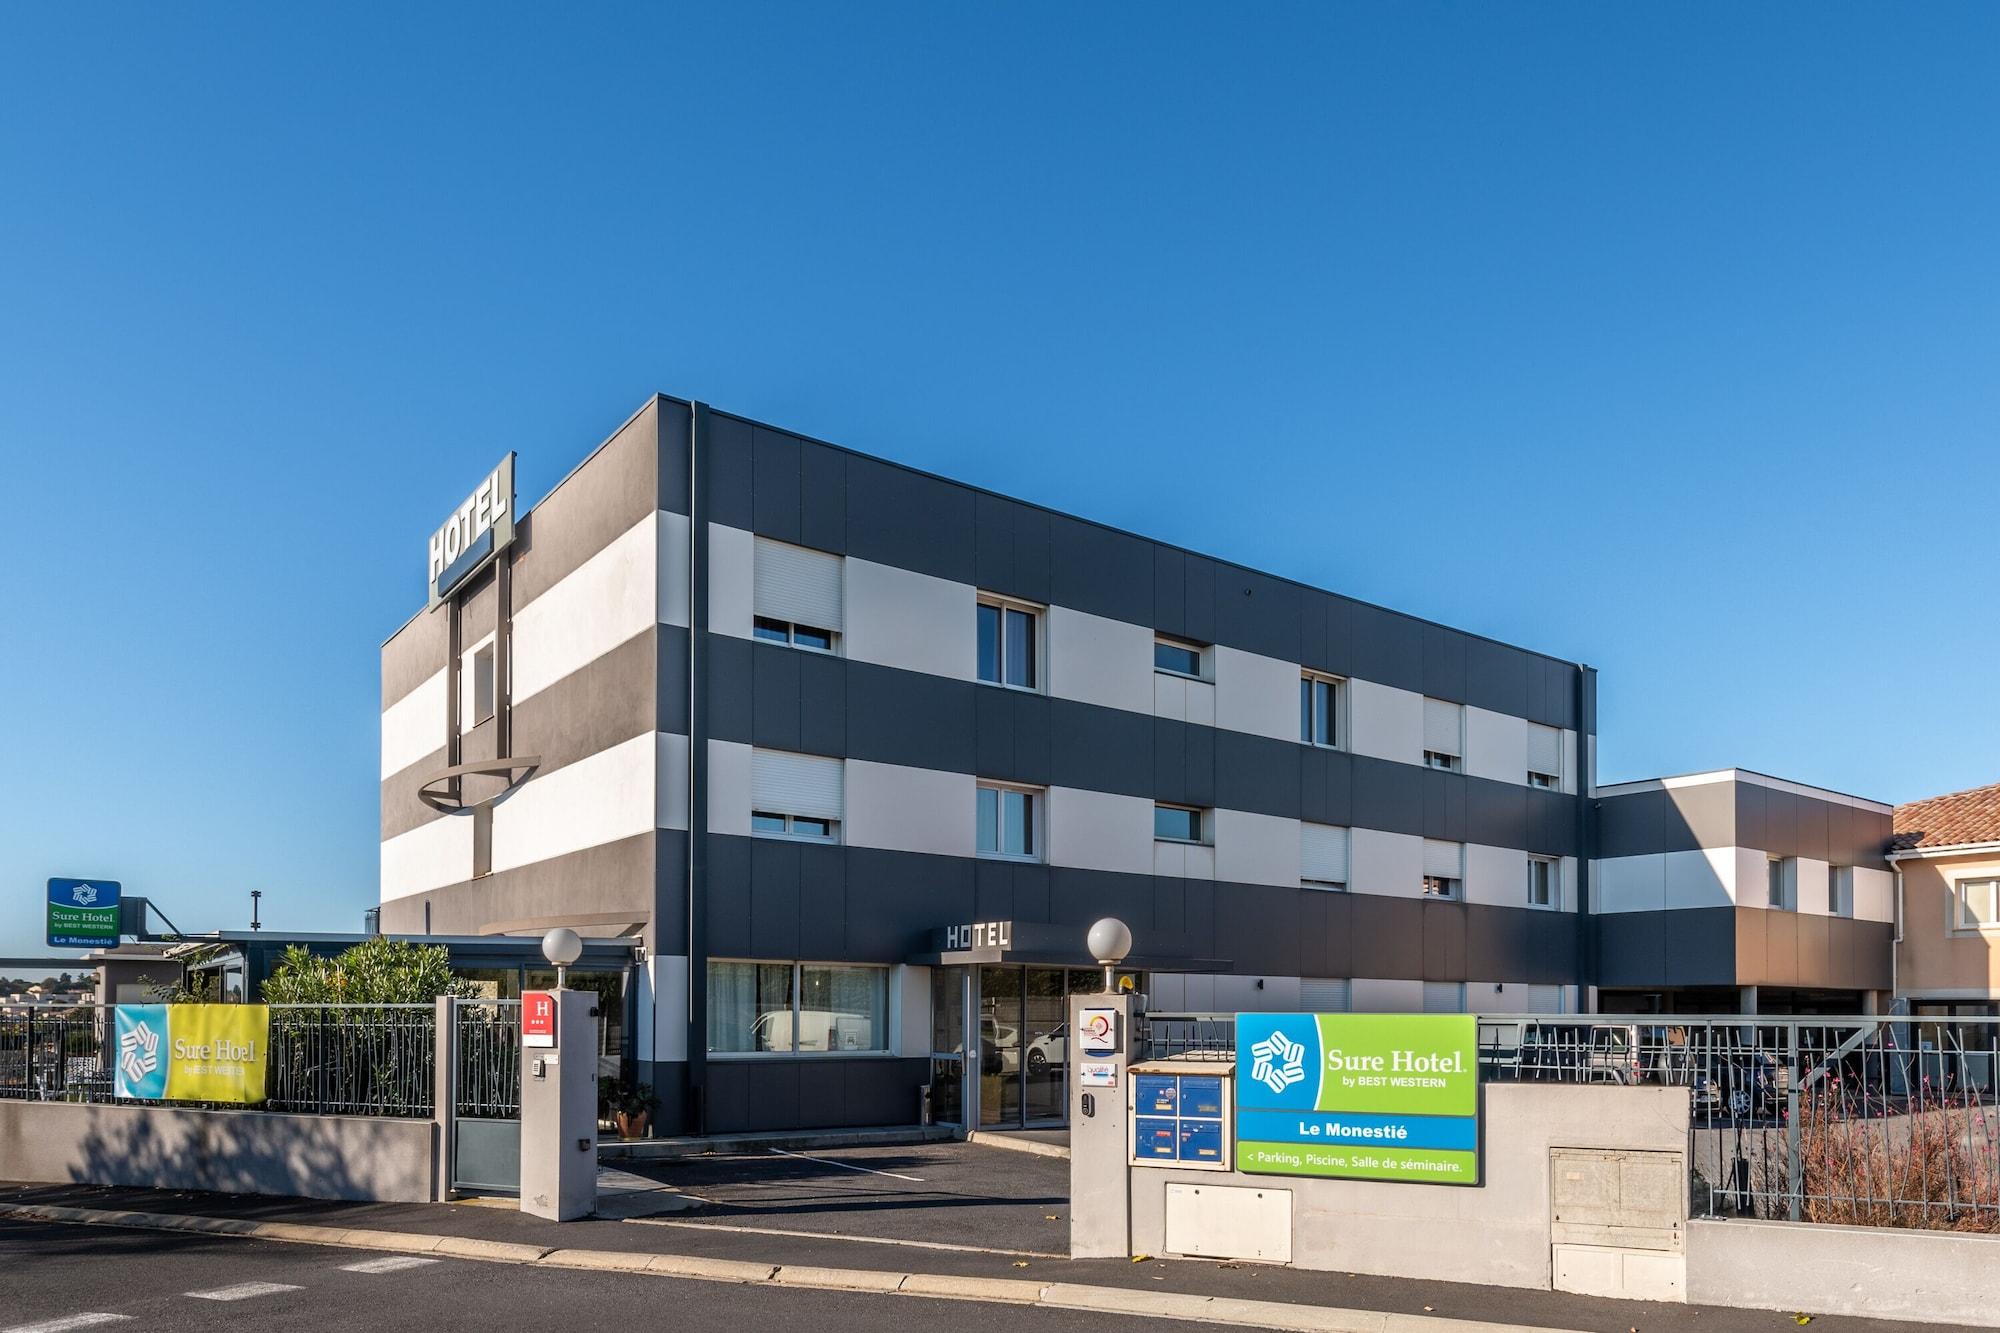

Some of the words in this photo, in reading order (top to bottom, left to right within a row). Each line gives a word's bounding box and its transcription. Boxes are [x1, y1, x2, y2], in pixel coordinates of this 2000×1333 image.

[430, 469, 507, 584] HOTEL
[52, 911, 79, 921] Sure
[68, 937, 113, 945] Monestié
[947, 921, 1008, 949] HOTEL
[536, 1001, 549, 1016] H
[175, 1038, 211, 1061] Sure
[1328, 1049, 1384, 1071] Sure
[1342, 1076, 1355, 1088] by
[1358, 1076, 1387, 1086] BEST
[1390, 1077, 1446, 1088] WESTERN
[1299, 1121, 1321, 1136] Le
[1325, 1122, 1408, 1139] Monestié
[1257, 1151, 1303, 1167] Parking,
[1306, 1154, 1348, 1168] Piscine,
[1351, 1156, 1379, 1168] Salle
[1382, 1157, 1397, 1169] de
[1400, 1159, 1463, 1172] séminaire.
